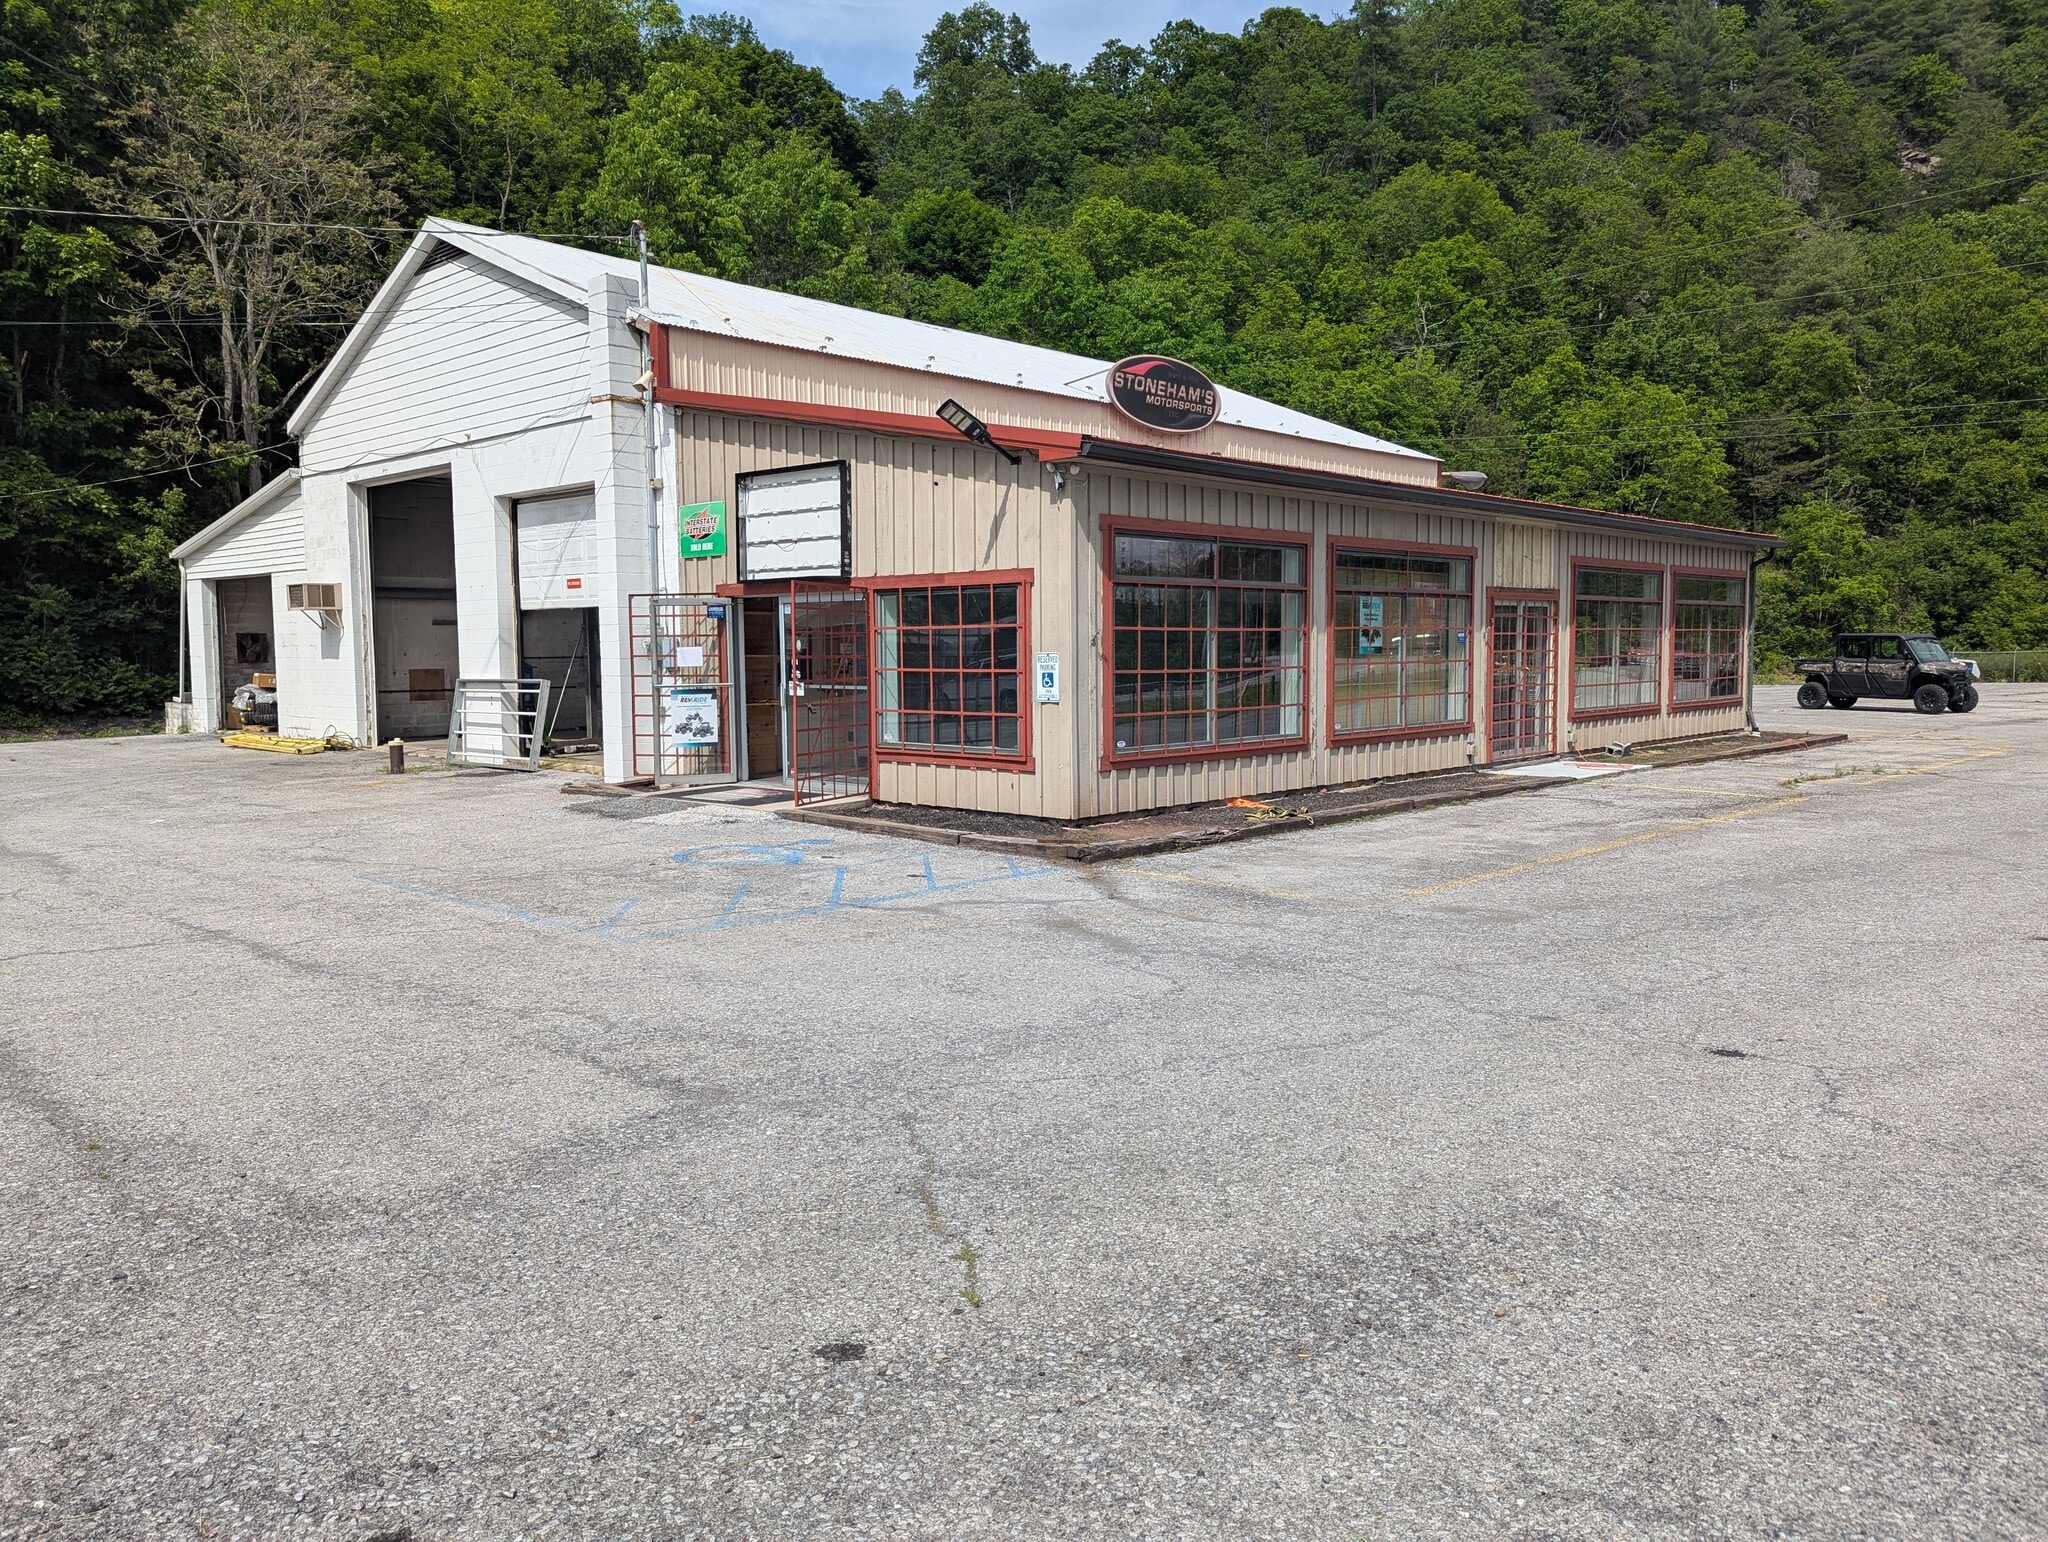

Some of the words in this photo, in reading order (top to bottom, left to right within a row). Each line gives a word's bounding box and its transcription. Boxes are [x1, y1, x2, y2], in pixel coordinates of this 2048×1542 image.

[1114, 371, 1214, 405] STONEHAM'S
[1145, 394, 1213, 415] MOTORSPORTS
[685, 517, 717, 526] INTERSTATE
[685, 526, 715, 534] BATTERIES
[690, 543, 701, 551] SOLD
[702, 542, 713, 550] HERE
[1037, 655, 1058, 663] RESERVED
